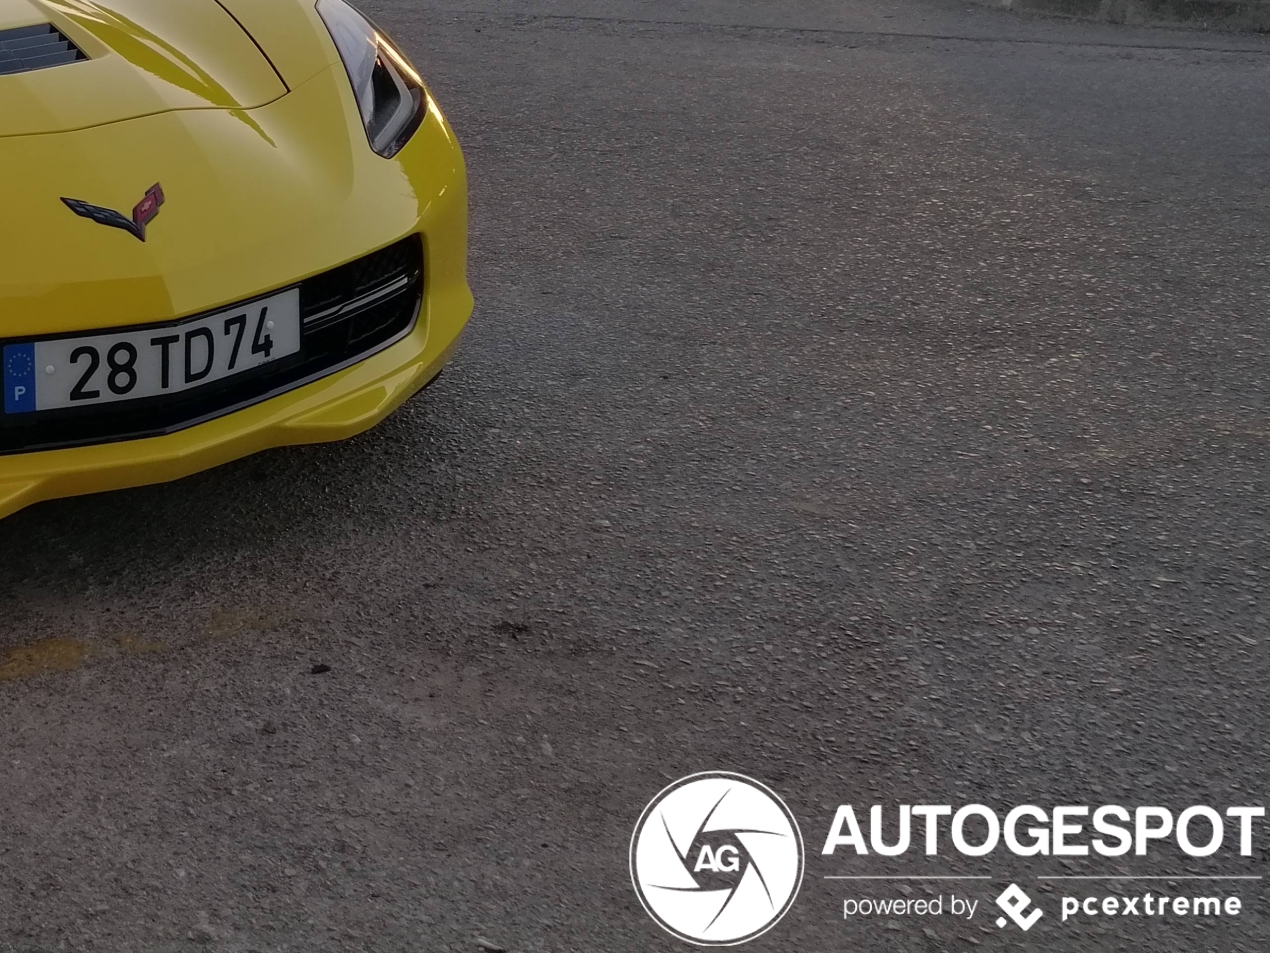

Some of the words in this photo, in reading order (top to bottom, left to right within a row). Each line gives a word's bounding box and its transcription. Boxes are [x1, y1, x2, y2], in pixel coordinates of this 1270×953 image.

[69, 341, 138, 401] 28
[150, 326, 215, 389] TD
[223, 306, 274, 370] 74
[14, 386, 26, 401] P
